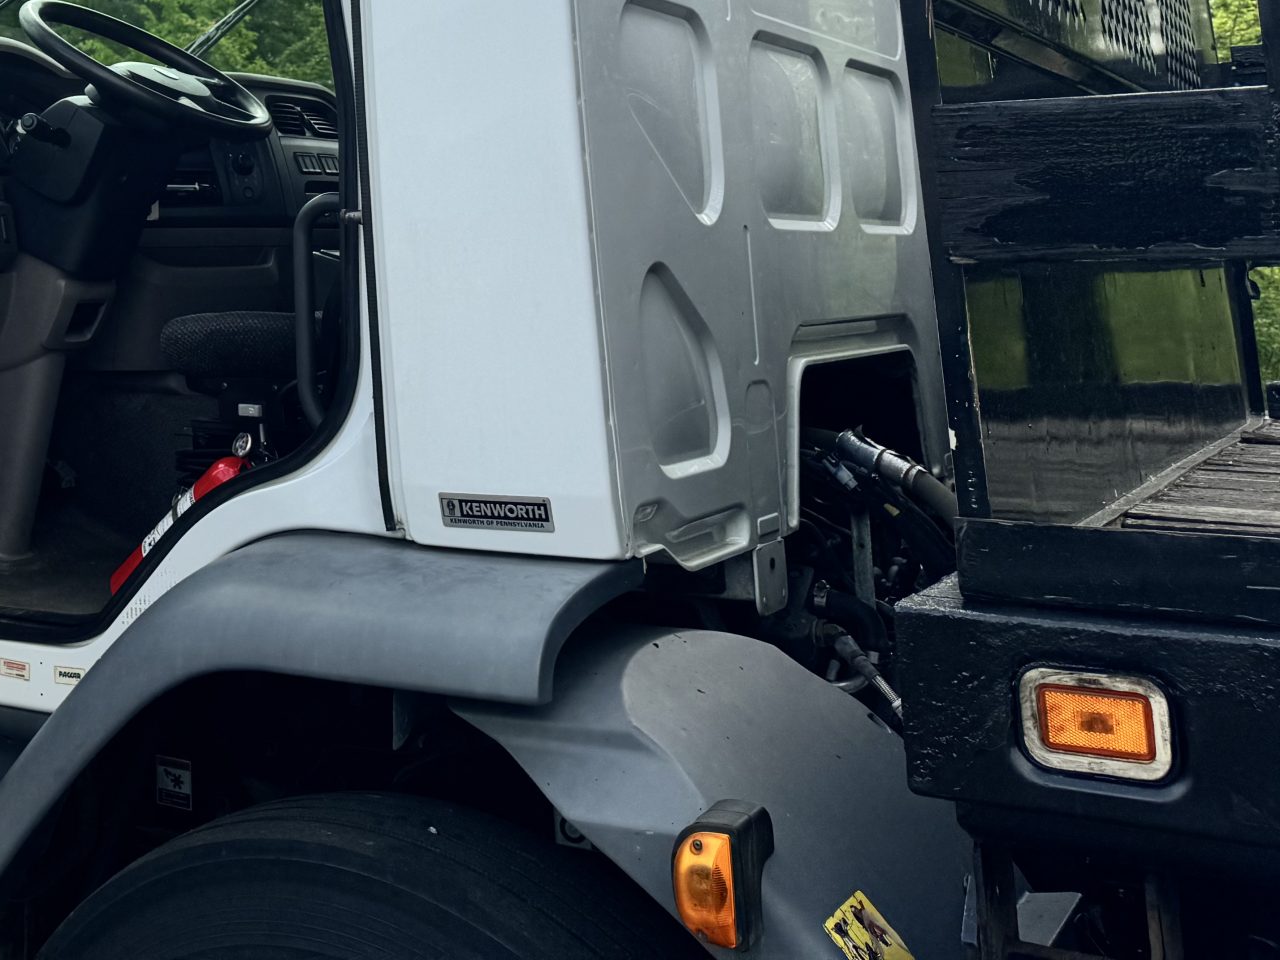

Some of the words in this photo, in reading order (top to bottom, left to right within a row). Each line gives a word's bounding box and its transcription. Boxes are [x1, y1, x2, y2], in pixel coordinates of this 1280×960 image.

[462, 502, 546, 519] KENWORTH
[450, 518, 485, 526] KENWORTH
[496, 520, 545, 529] PENNSYLVANIA
